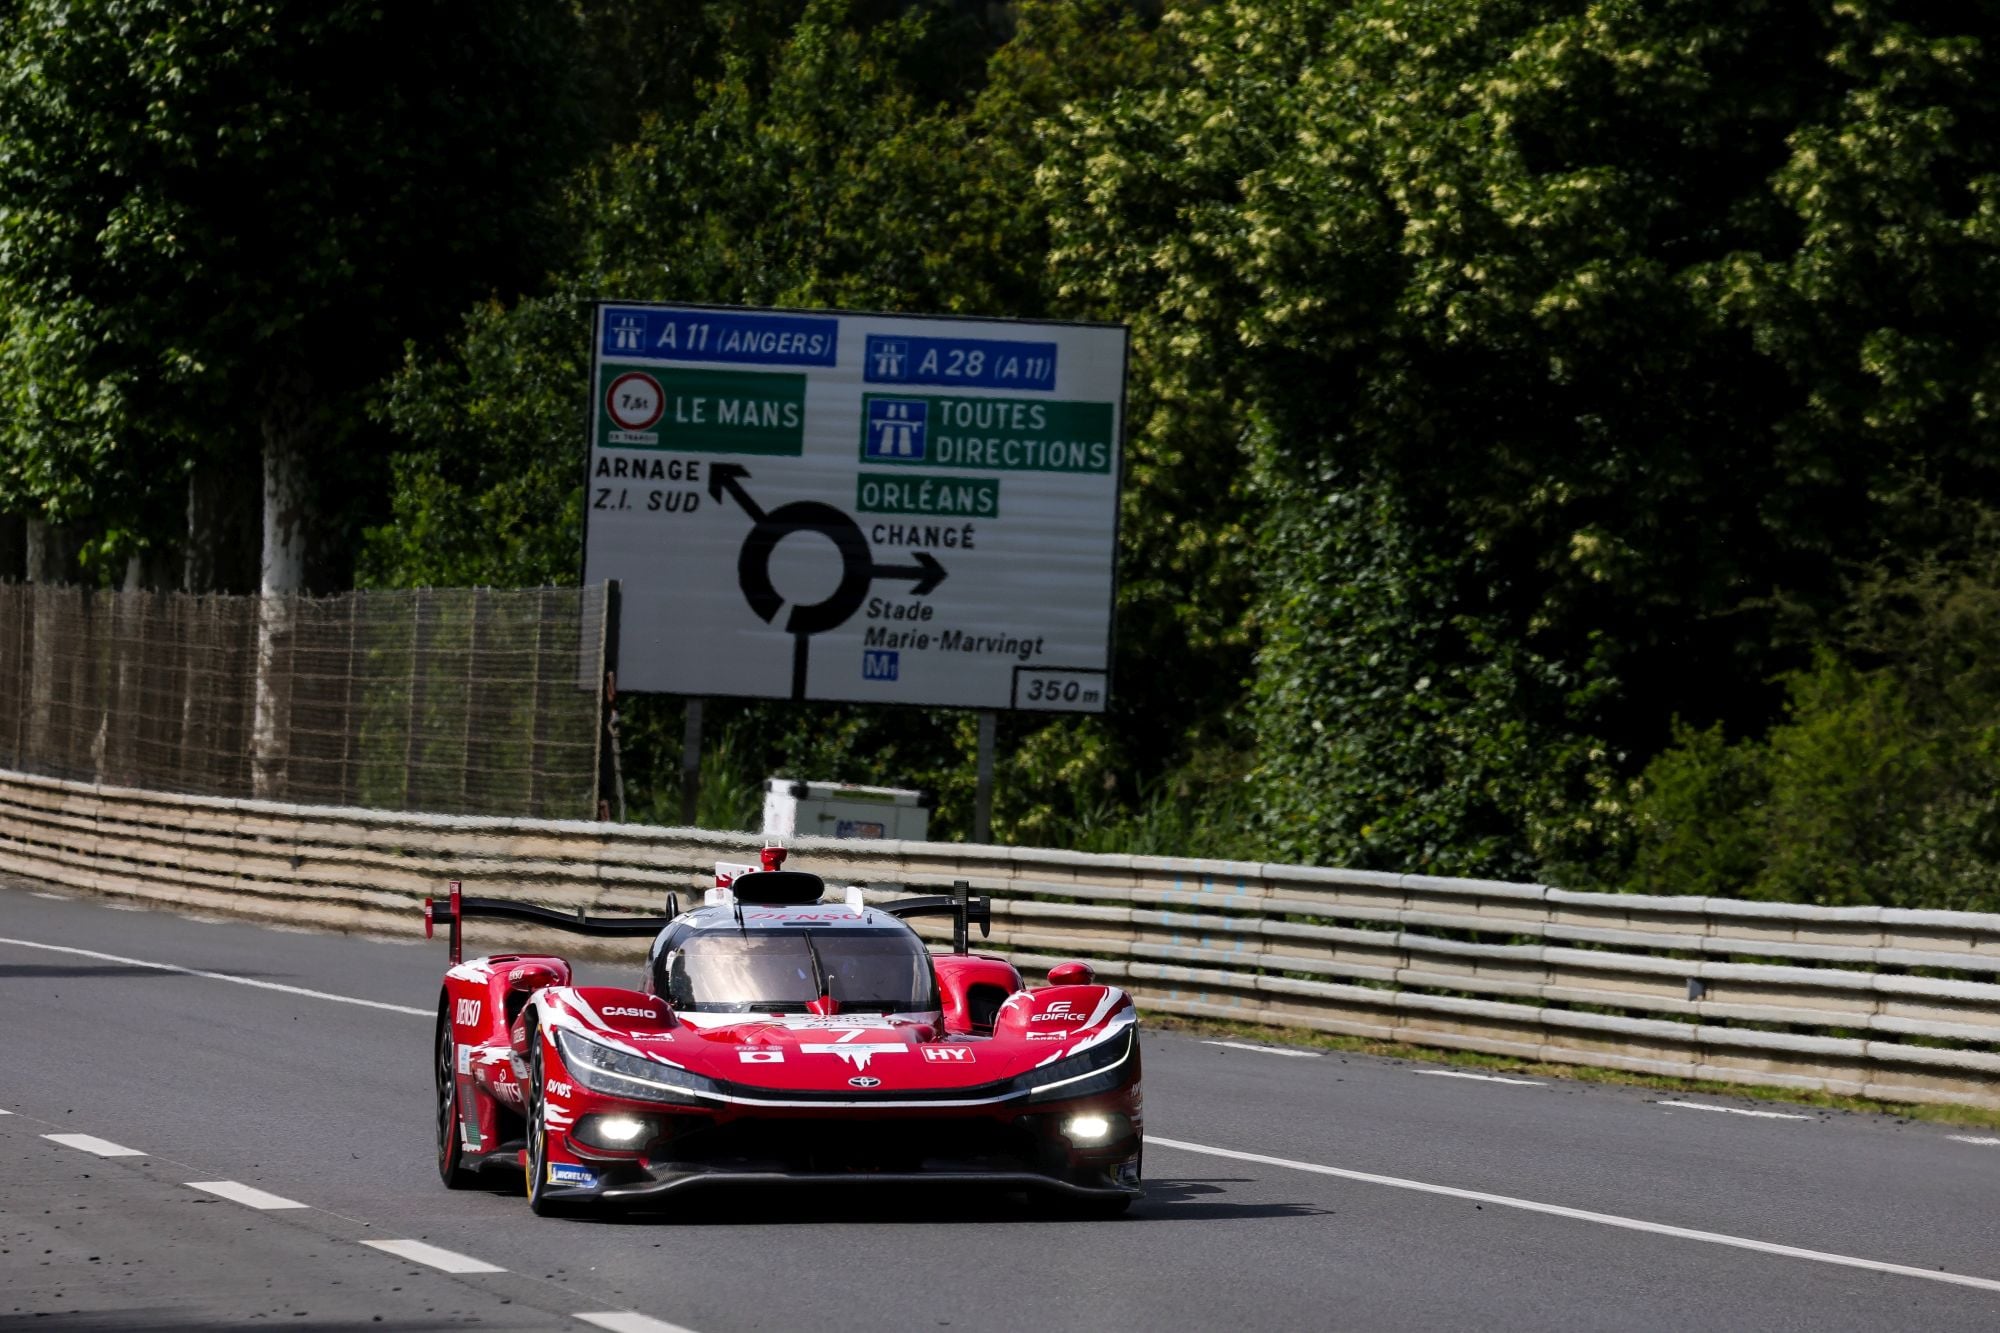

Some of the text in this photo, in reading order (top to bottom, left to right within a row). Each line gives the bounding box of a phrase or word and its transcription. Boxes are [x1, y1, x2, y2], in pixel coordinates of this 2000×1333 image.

[656, 322, 832, 357] A 11 (ANGERS)
[676, 397, 799, 428] LE MANS
[940, 401, 1046, 430] TOUTES
[936, 436, 1106, 468] DIRECTIONS
[596, 457, 700, 481] ARNAGE
[593, 488, 700, 513] Z.I. SUD
[862, 480, 993, 513] ORLÉANS
[871, 523, 976, 549] CHANGÉ
[866, 598, 933, 621] Stade
[864, 626, 1044, 660] Marie-Marvingt
[748, 913, 863, 921] DENSO
[456, 998, 481, 1027] DENSO
[602, 1006, 657, 1019] CASIO
[1030, 1012, 1087, 1022] EDIFICE
[828, 1028, 866, 1043] 7
[926, 1049, 967, 1060] HY
